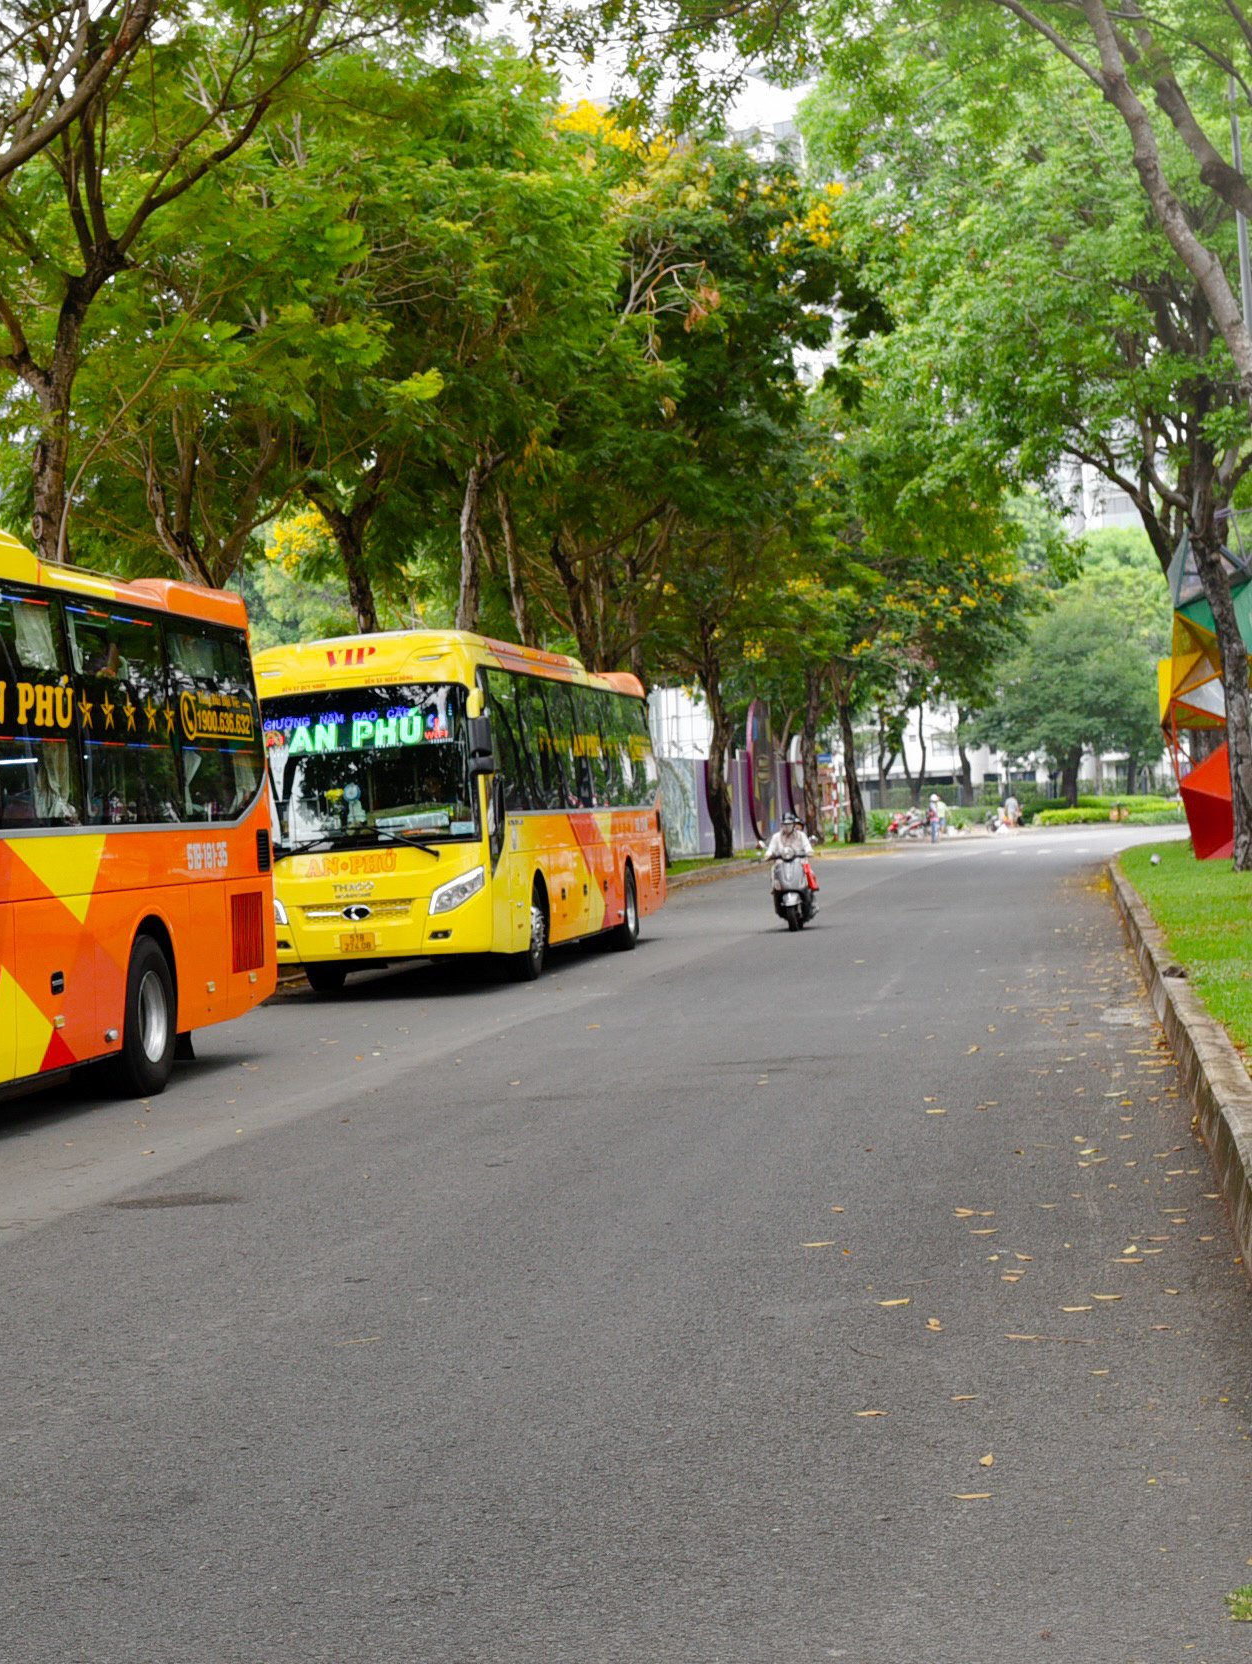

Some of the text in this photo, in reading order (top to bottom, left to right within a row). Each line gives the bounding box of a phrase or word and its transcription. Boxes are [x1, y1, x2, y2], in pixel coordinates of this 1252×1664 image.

[326, 646, 377, 667] VIP
[16, 674, 74, 728] PHÚ
[351, 710, 378, 722] CAO
[289, 706, 423, 753] AN PHÚ
[305, 857, 340, 879] AN
